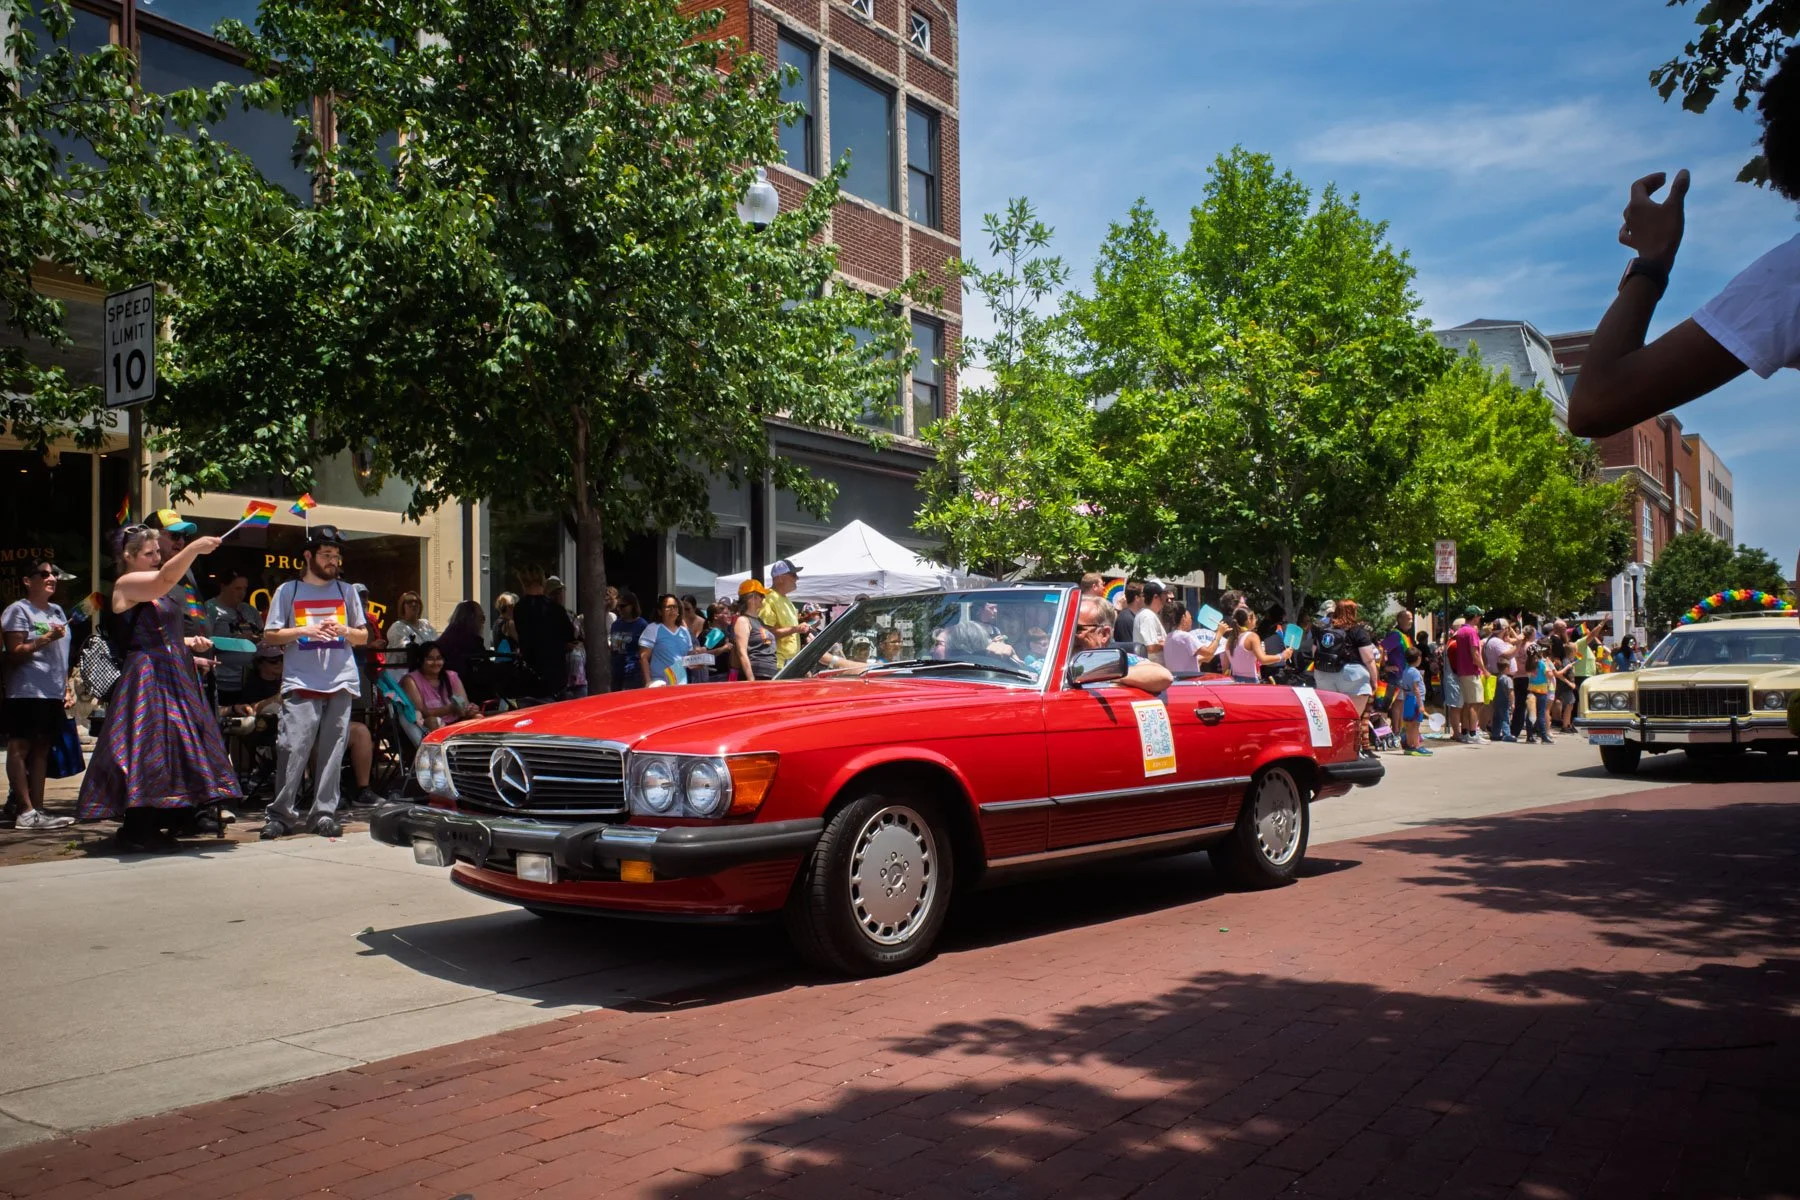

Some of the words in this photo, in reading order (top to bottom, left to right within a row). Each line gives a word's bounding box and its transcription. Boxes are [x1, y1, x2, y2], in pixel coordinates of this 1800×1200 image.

[107, 297, 151, 323] SPEED
[112, 323, 146, 346] LIMIT
[112, 348, 146, 394] 10
